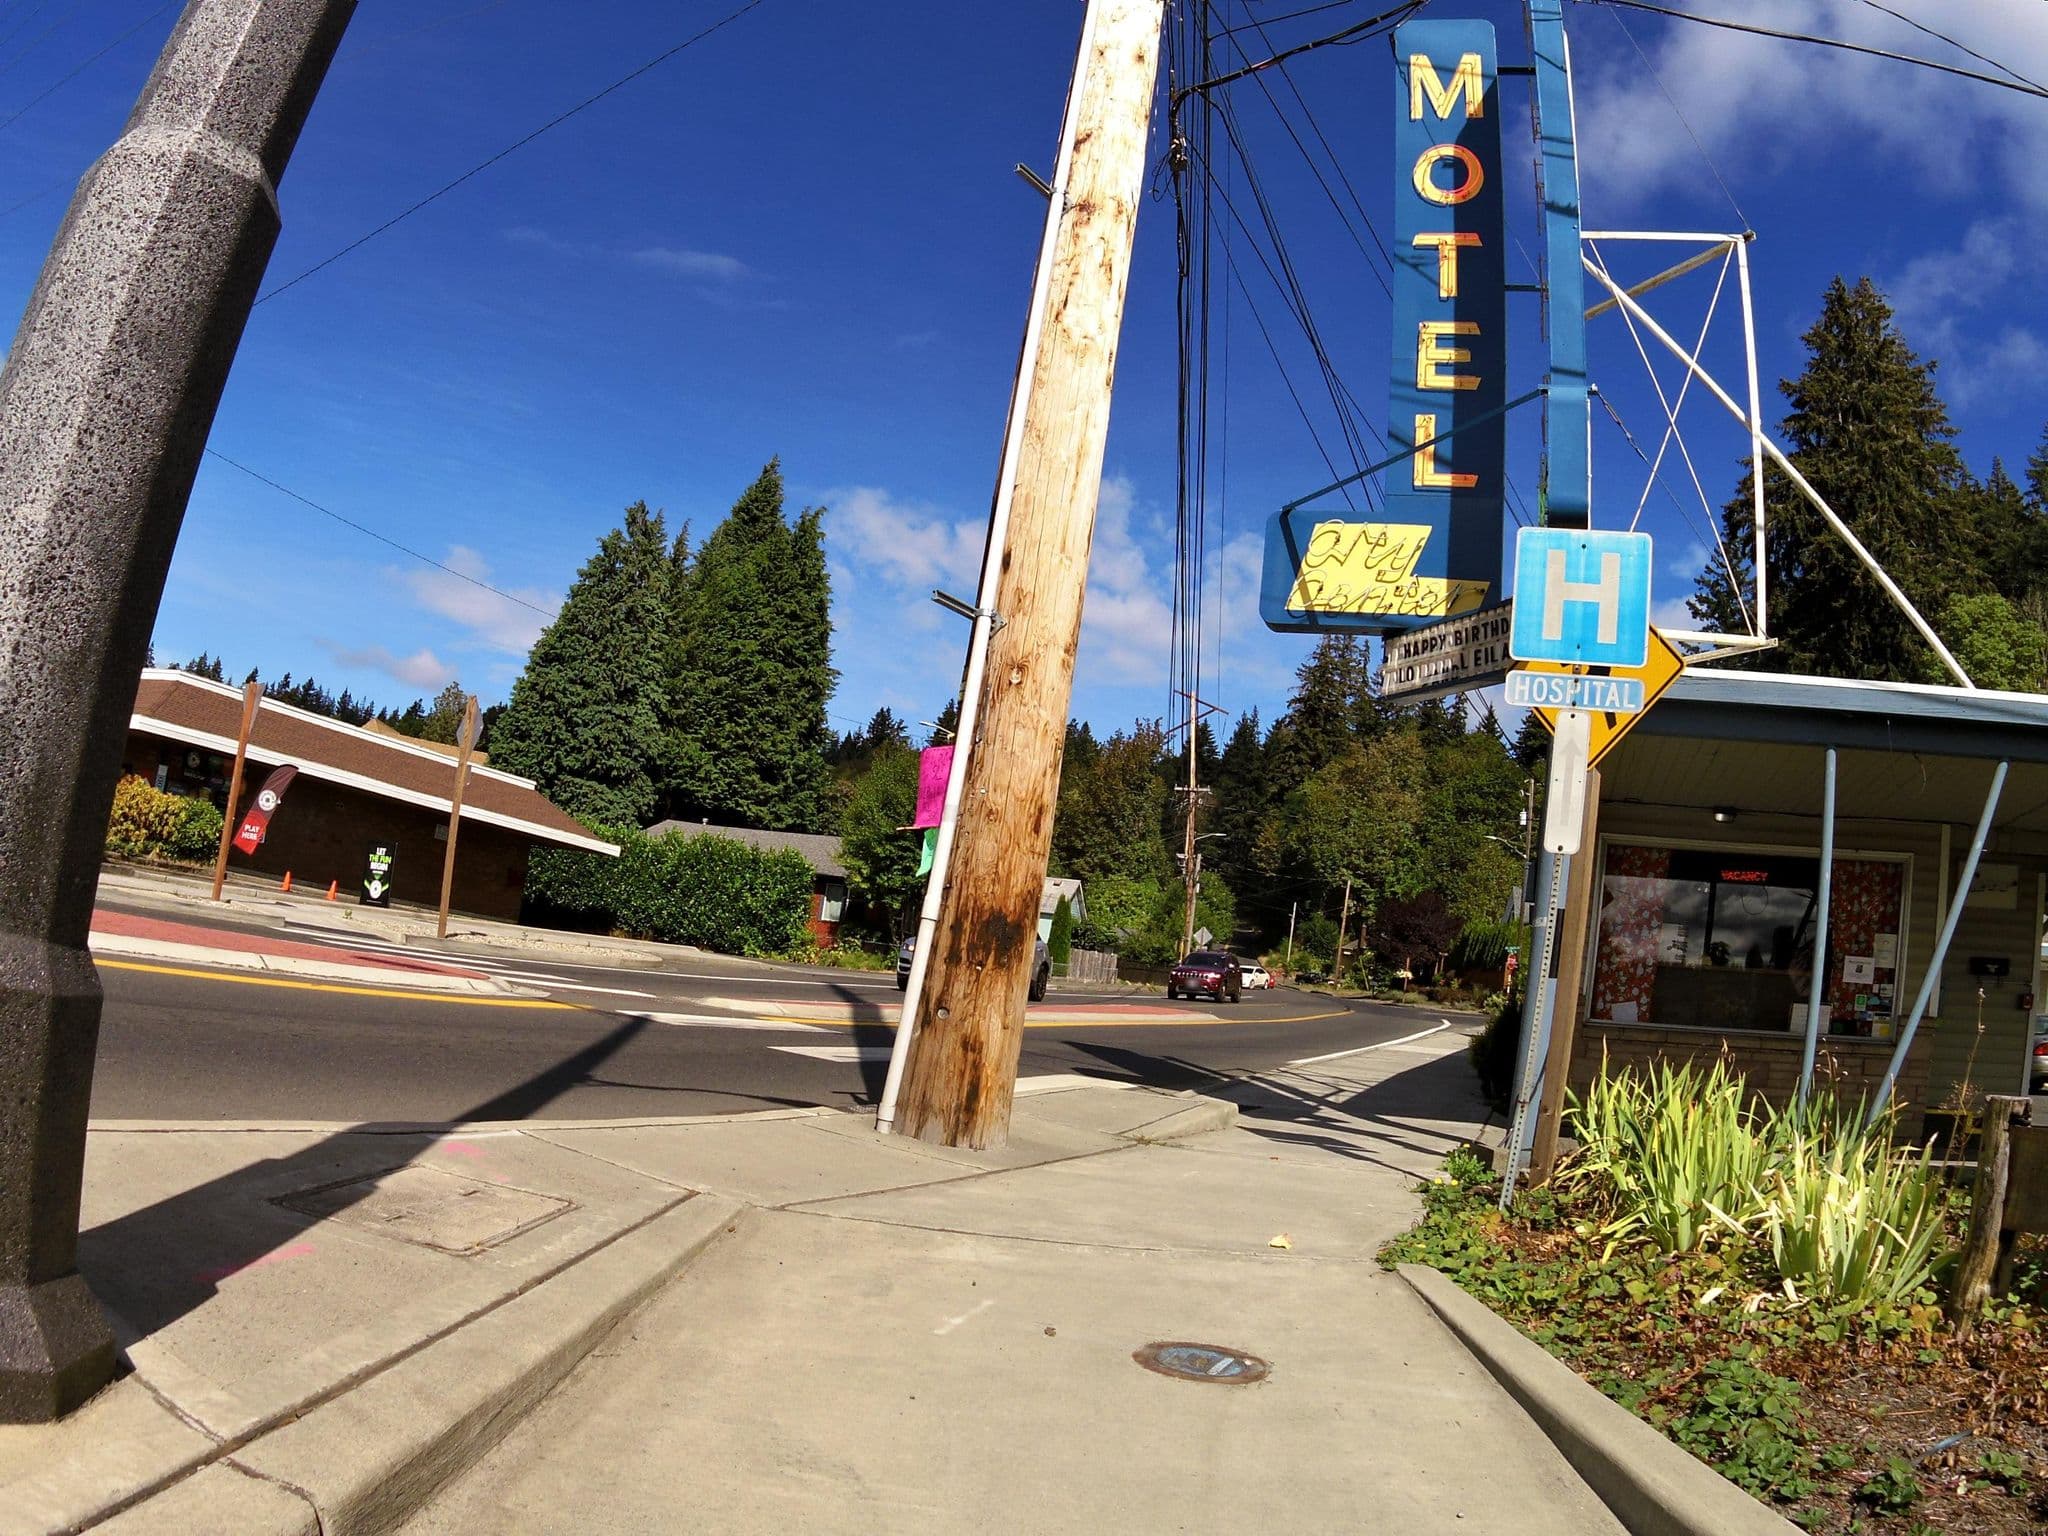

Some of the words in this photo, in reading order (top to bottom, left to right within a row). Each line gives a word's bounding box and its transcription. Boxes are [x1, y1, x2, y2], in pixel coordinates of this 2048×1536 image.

[1408, 52, 1484, 489] MOTEL
[1542, 549, 1621, 645] H
[1402, 633, 1447, 659] HAPPY
[1514, 675, 1637, 709] HOSPITAL
[241, 831, 258, 840] HERE
[244, 824, 260, 833] PLAY
[1720, 868, 1769, 882] VACANCY
